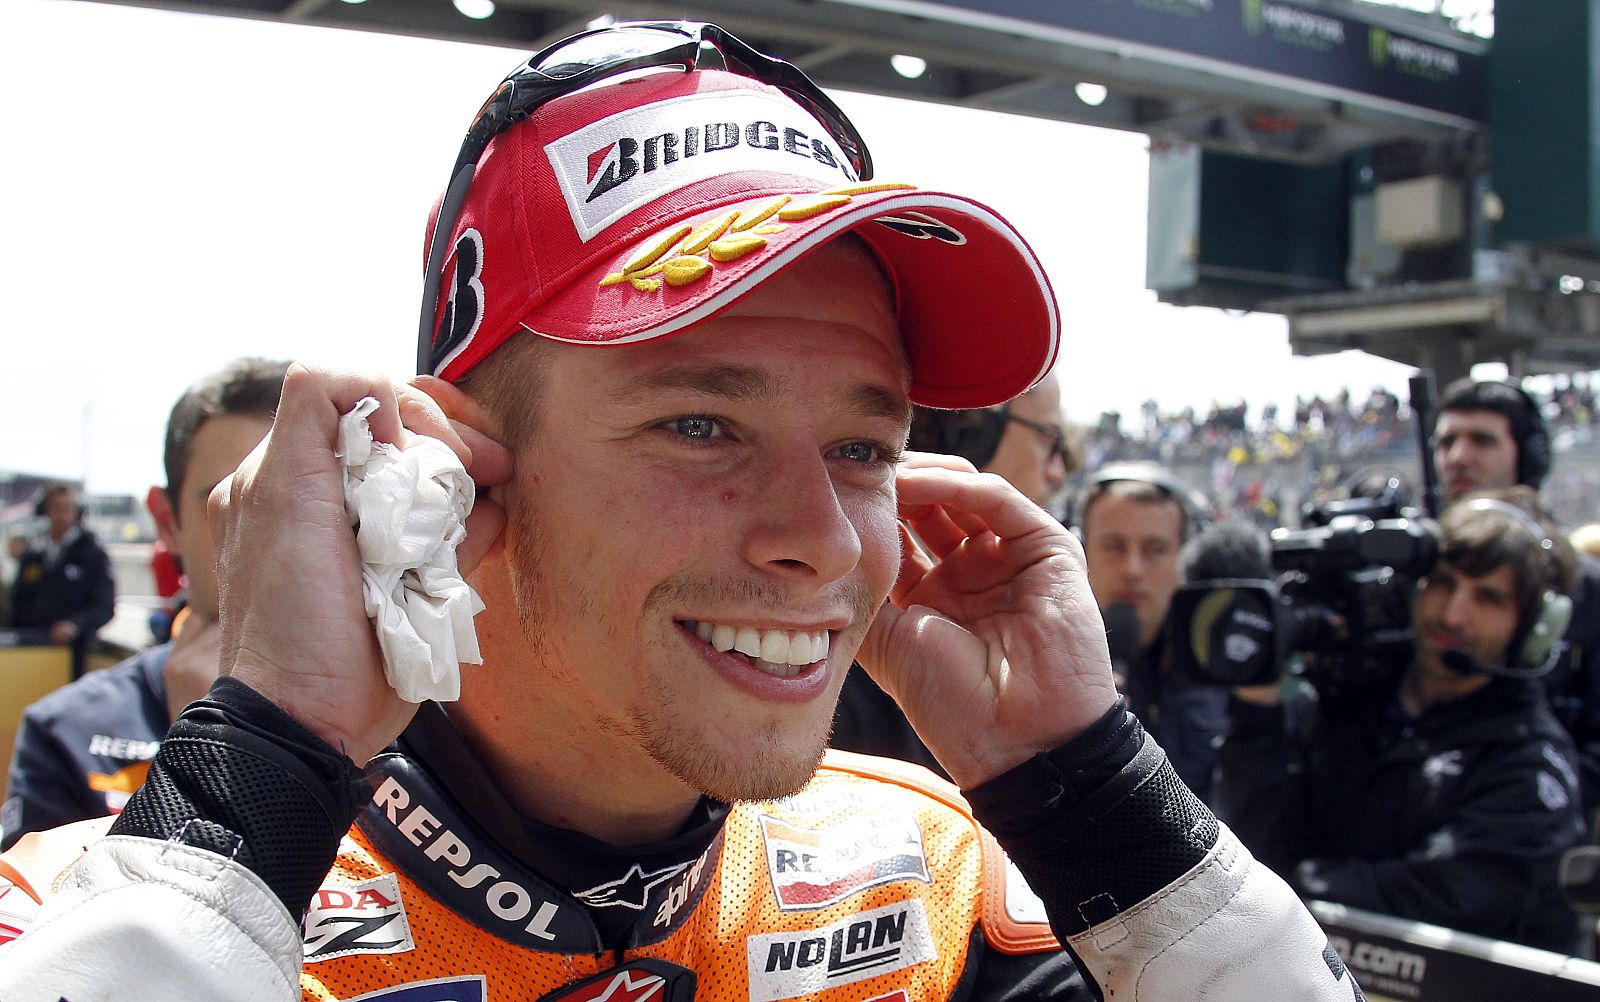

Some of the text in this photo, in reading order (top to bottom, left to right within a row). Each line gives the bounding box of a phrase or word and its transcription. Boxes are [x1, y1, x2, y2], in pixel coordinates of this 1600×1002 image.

[586, 120, 860, 203] BRIDGES
[372, 775, 562, 941] REPSOL
[765, 911, 907, 974] NOLAN
